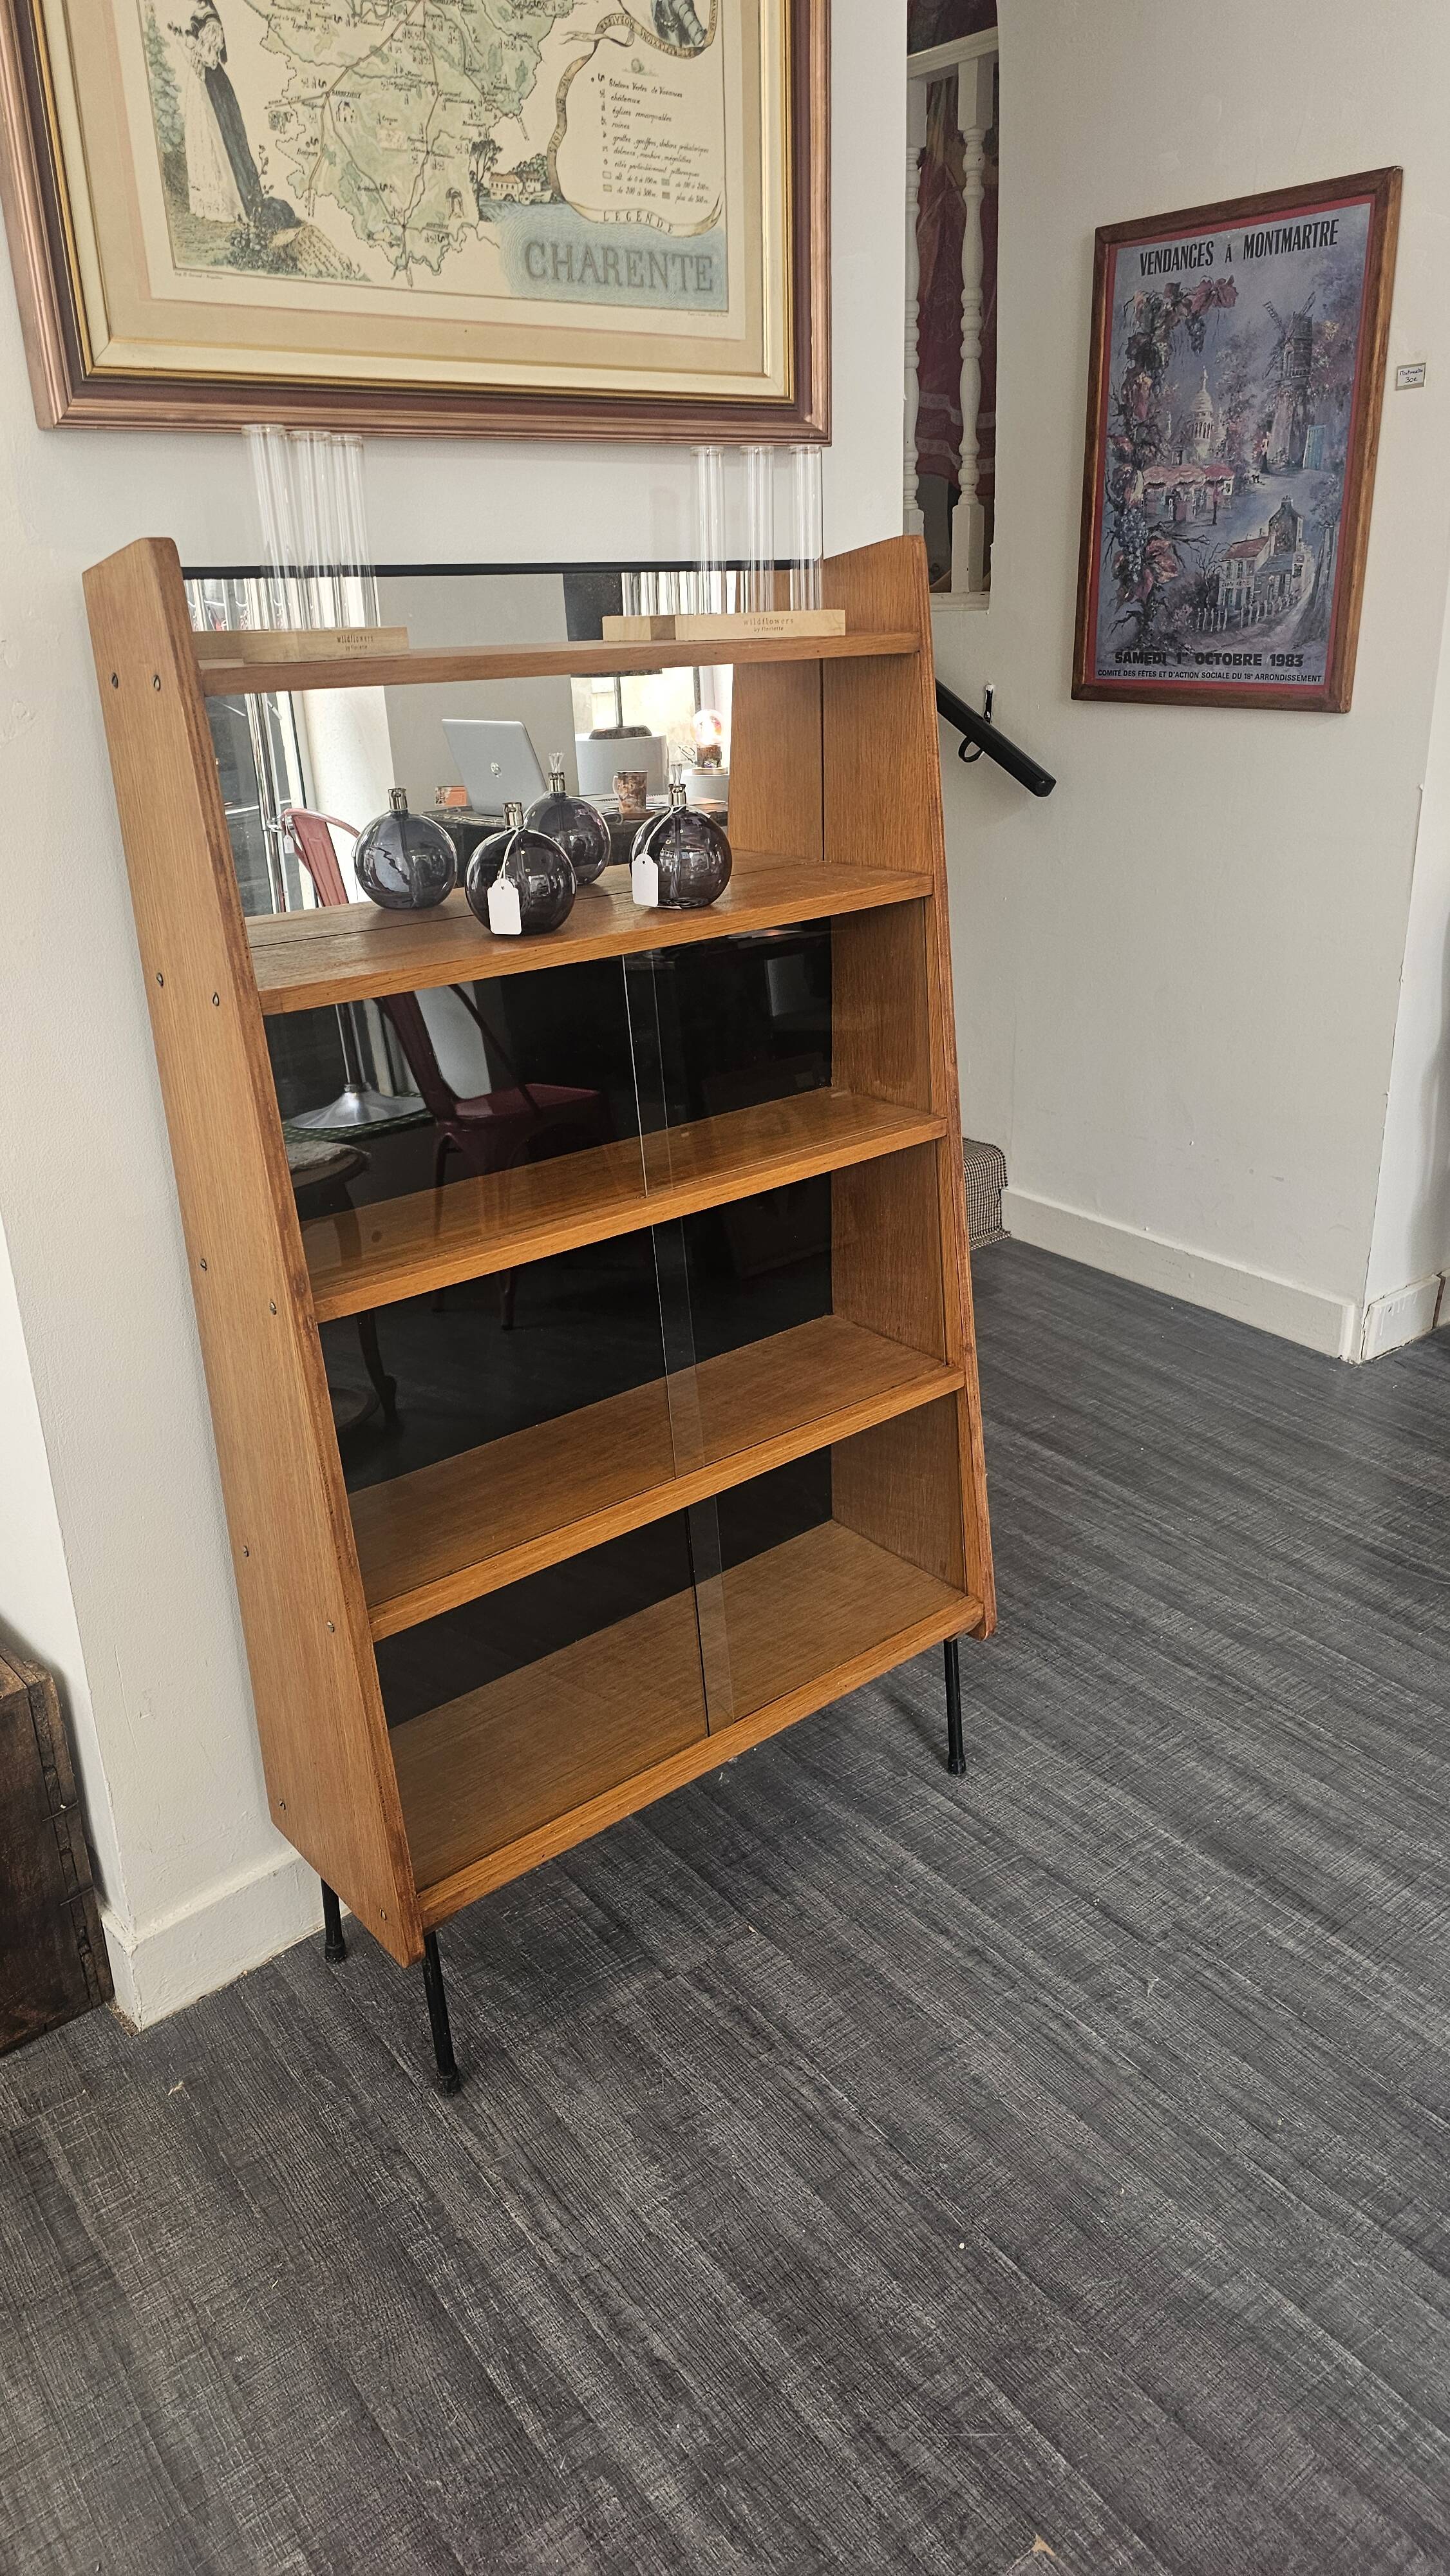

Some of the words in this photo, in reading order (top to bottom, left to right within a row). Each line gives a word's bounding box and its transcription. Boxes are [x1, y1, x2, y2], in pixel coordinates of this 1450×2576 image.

[609, 78, 629, 90] Stations
[632, 82, 647, 92] Vertes
[1140, 241, 1214, 276] VENDANGES
[1243, 219, 1339, 260] MONTMARTRE
[525, 241, 713, 291] CHARENTE
[1115, 651, 1167, 666] SAMEDI
[1195, 652, 1262, 667] OCTOBRE
[1269, 654, 1304, 667] 1983
[1255, 673, 1322, 682] ARRONDISSEMENT
